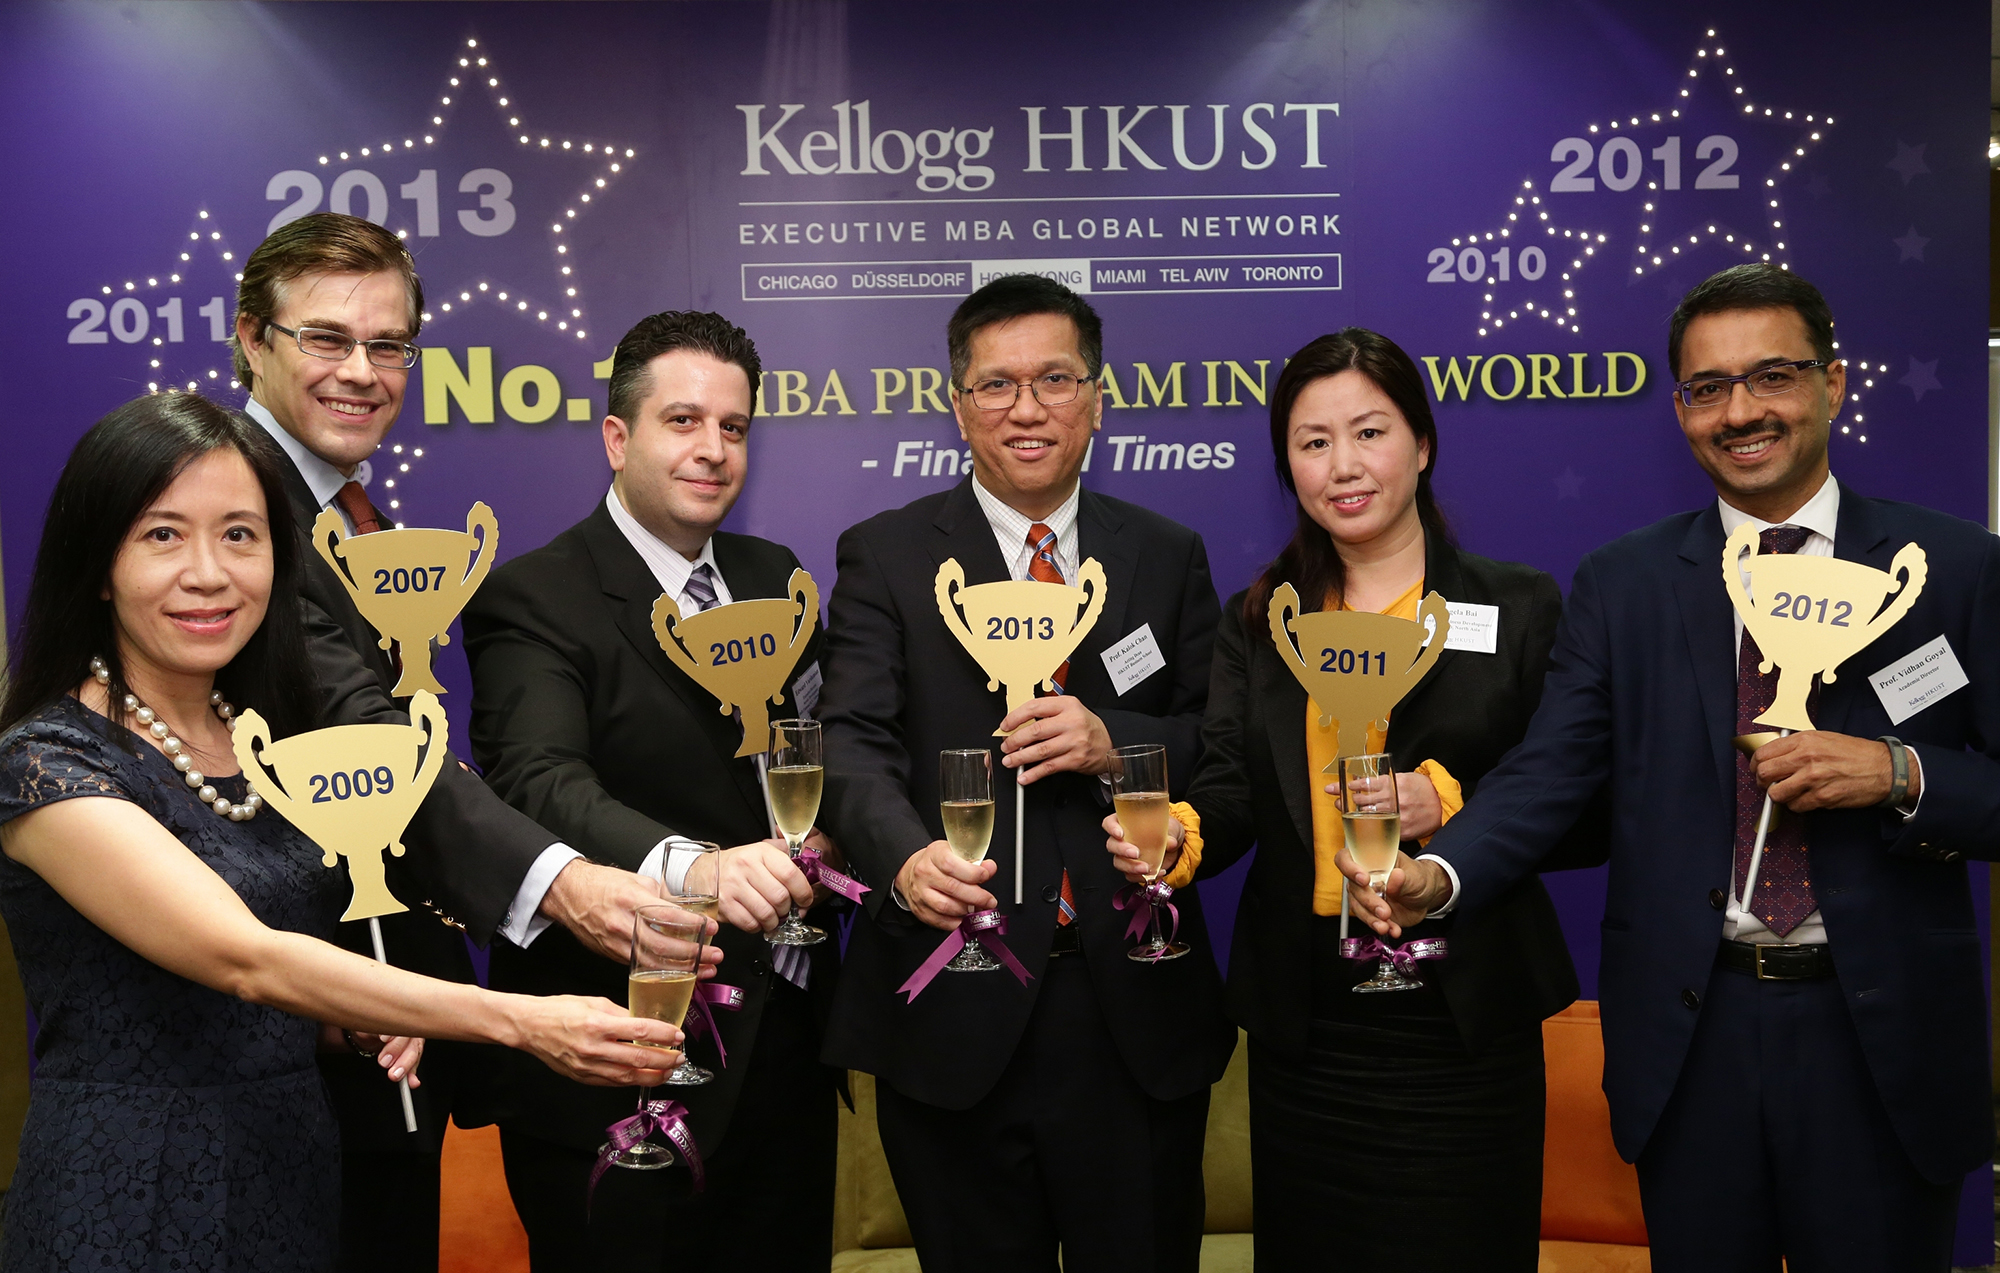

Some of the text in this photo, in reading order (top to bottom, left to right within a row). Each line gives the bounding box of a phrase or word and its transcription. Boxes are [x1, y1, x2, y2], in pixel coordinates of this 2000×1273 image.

[735, 99, 1340, 192] Kellogg HKUST
[1550, 135, 1739, 192] 2012
[265, 168, 516, 237] 2013
[739, 214, 1341, 244] EXECUTIVE MBA GLOBAL NETWORK
[758, 271, 966, 290] CHICAGO DÜSSELDORF
[1096, 265, 1323, 284] MIAMI TEL AVIV TORONTO
[1427, 246, 1547, 283] 2010
[66, 297, 226, 344] 2011
[1202, 359, 1271, 406] IN
[1420, 352, 1647, 402] WORLD
[1108, 435, 1236, 471] Times
[374, 566, 446, 594] 2007
[1770, 592, 1853, 627] 2012
[987, 617, 1054, 640] 2013
[710, 633, 776, 666] 2010
[1320, 648, 1386, 676] 2011
[1879, 646, 1947, 690] Prof. Vidhan Goyal
[1898, 665, 1940, 692] Academic Director
[309, 766, 394, 803] 2009
